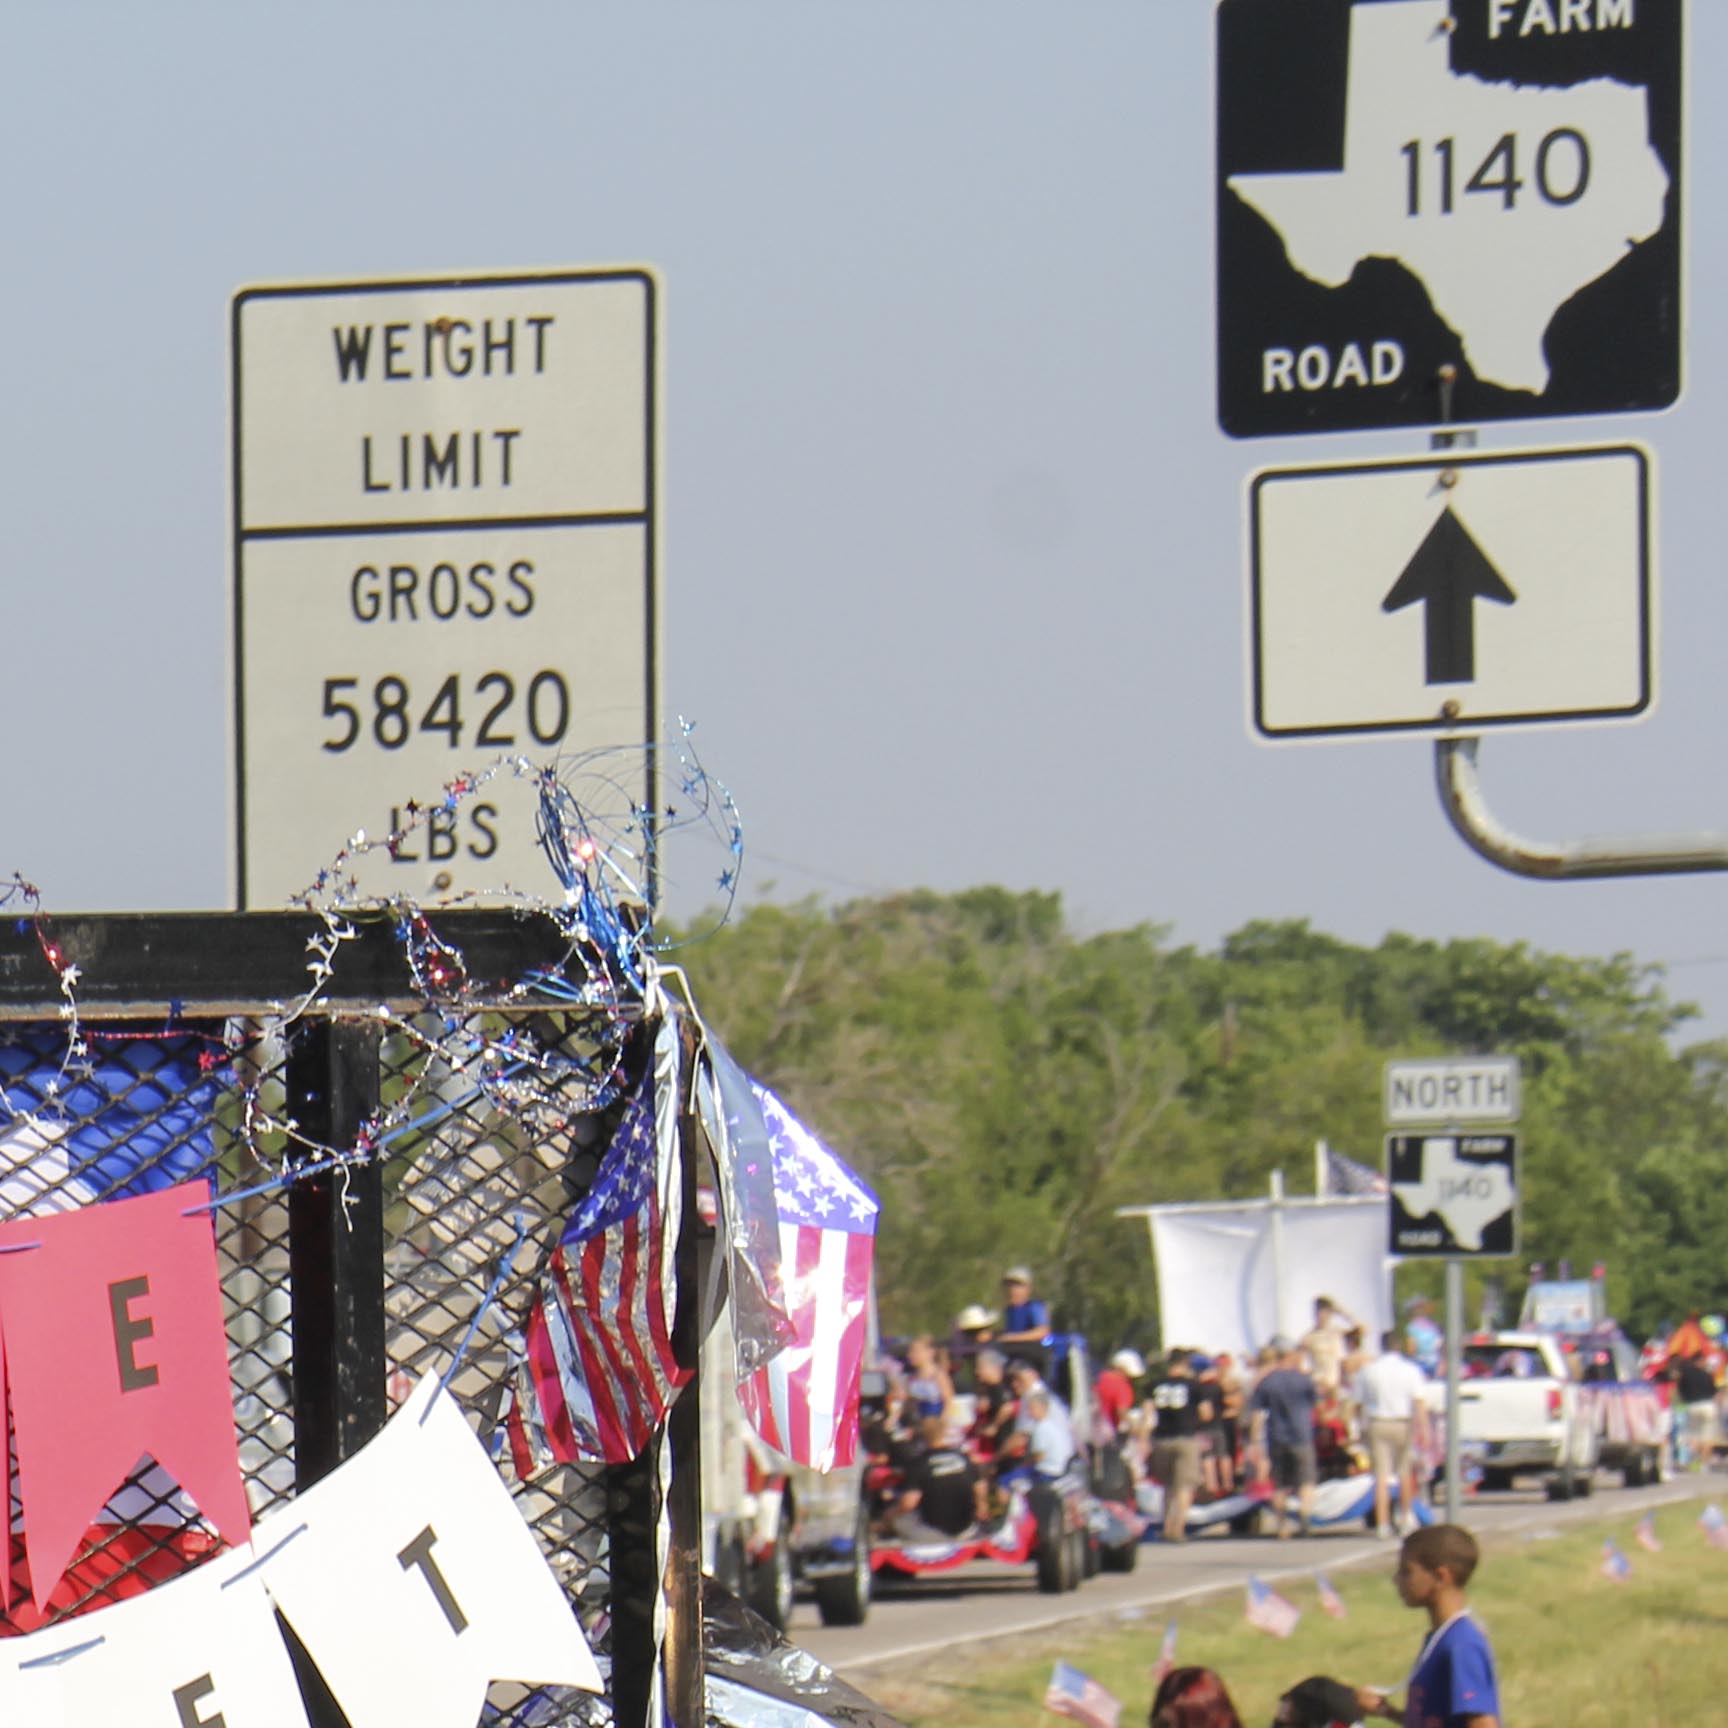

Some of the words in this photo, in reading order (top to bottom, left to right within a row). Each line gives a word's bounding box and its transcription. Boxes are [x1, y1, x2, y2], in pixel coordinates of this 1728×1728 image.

[1487, 0, 1635, 39] FARM
[1398, 126, 1592, 217] 1140
[332, 315, 556, 383] WEIGHT
[1261, 340, 1405, 394] ROAD
[361, 429, 523, 492] LIMIT
[350, 560, 536, 623] GROSS
[321, 669, 571, 754] 58420
[388, 803, 500, 864] LBS
[1393, 1074, 1507, 1109] NORTH
